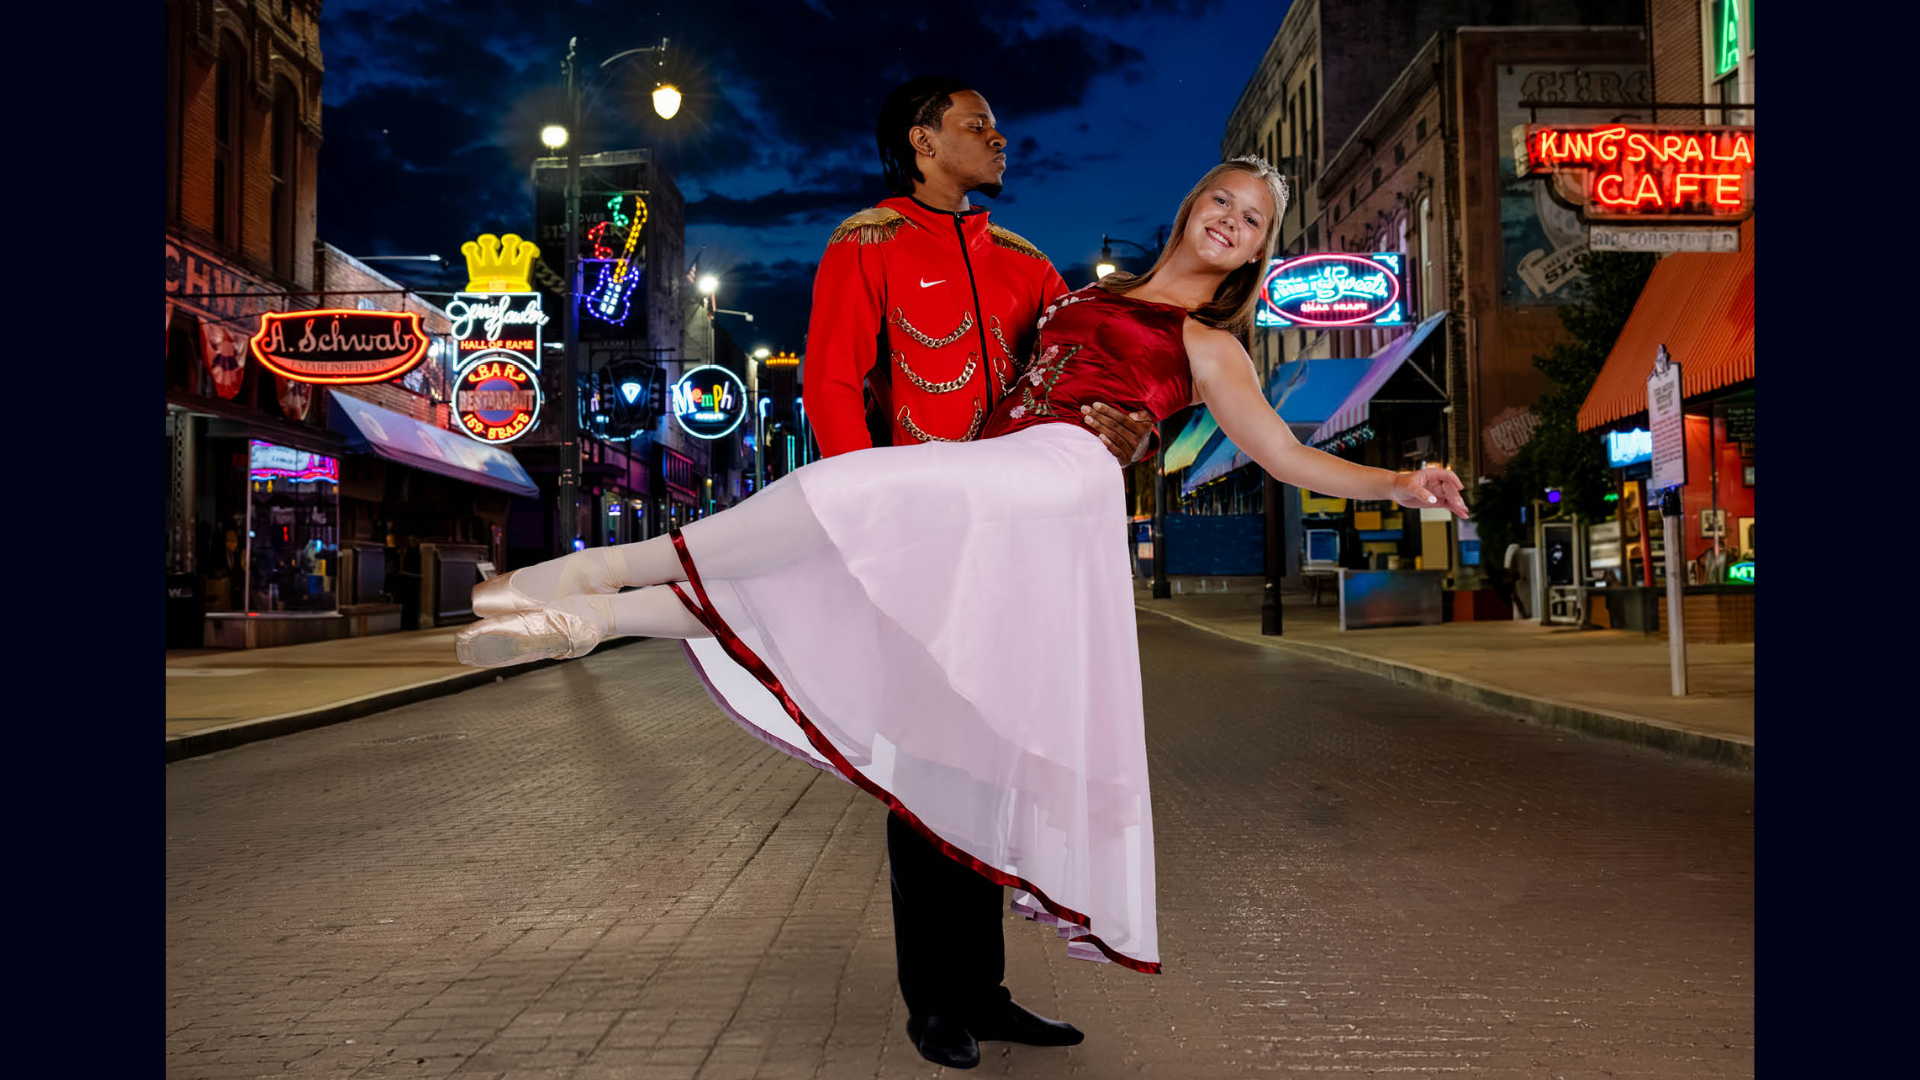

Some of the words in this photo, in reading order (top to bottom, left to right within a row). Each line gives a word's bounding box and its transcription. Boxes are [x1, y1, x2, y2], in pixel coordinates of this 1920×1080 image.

[1597, 173, 1741, 206] CAFE
[261, 320, 295, 353] A.
[298, 318, 418, 353] Schwab
[460, 341, 487, 350] HALL
[488, 341, 503, 350] OF
[506, 341, 535, 350] FAME
[476, 363, 519, 380] BAR
[458, 389, 537, 412] RESTAURANT
